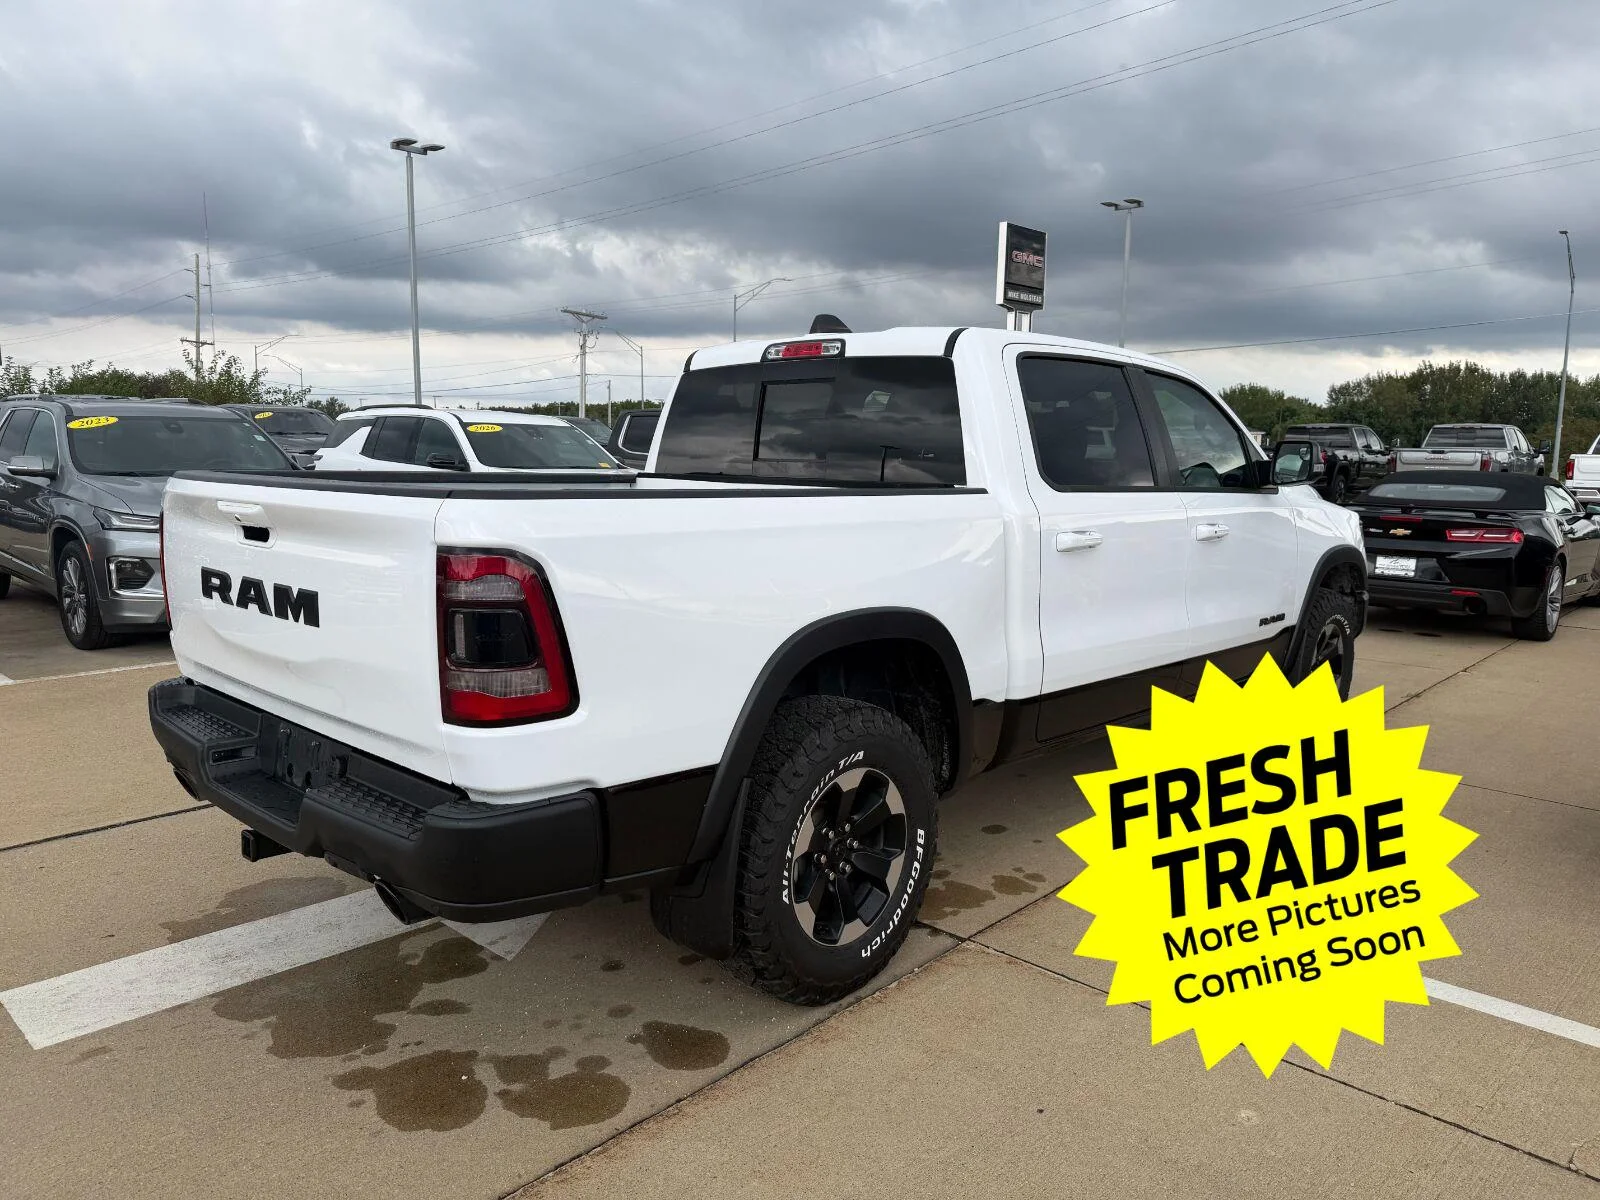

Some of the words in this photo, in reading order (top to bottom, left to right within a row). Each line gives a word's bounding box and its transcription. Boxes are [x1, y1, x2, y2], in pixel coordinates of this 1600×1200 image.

[1012, 250, 1044, 268] GMC
[78, 417, 110, 427] 2023
[200, 565, 320, 628] RAM
[1258, 612, 1286, 627] RAM
[838, 750, 865, 770] T/A
[861, 828, 926, 958] BFGoodrich
